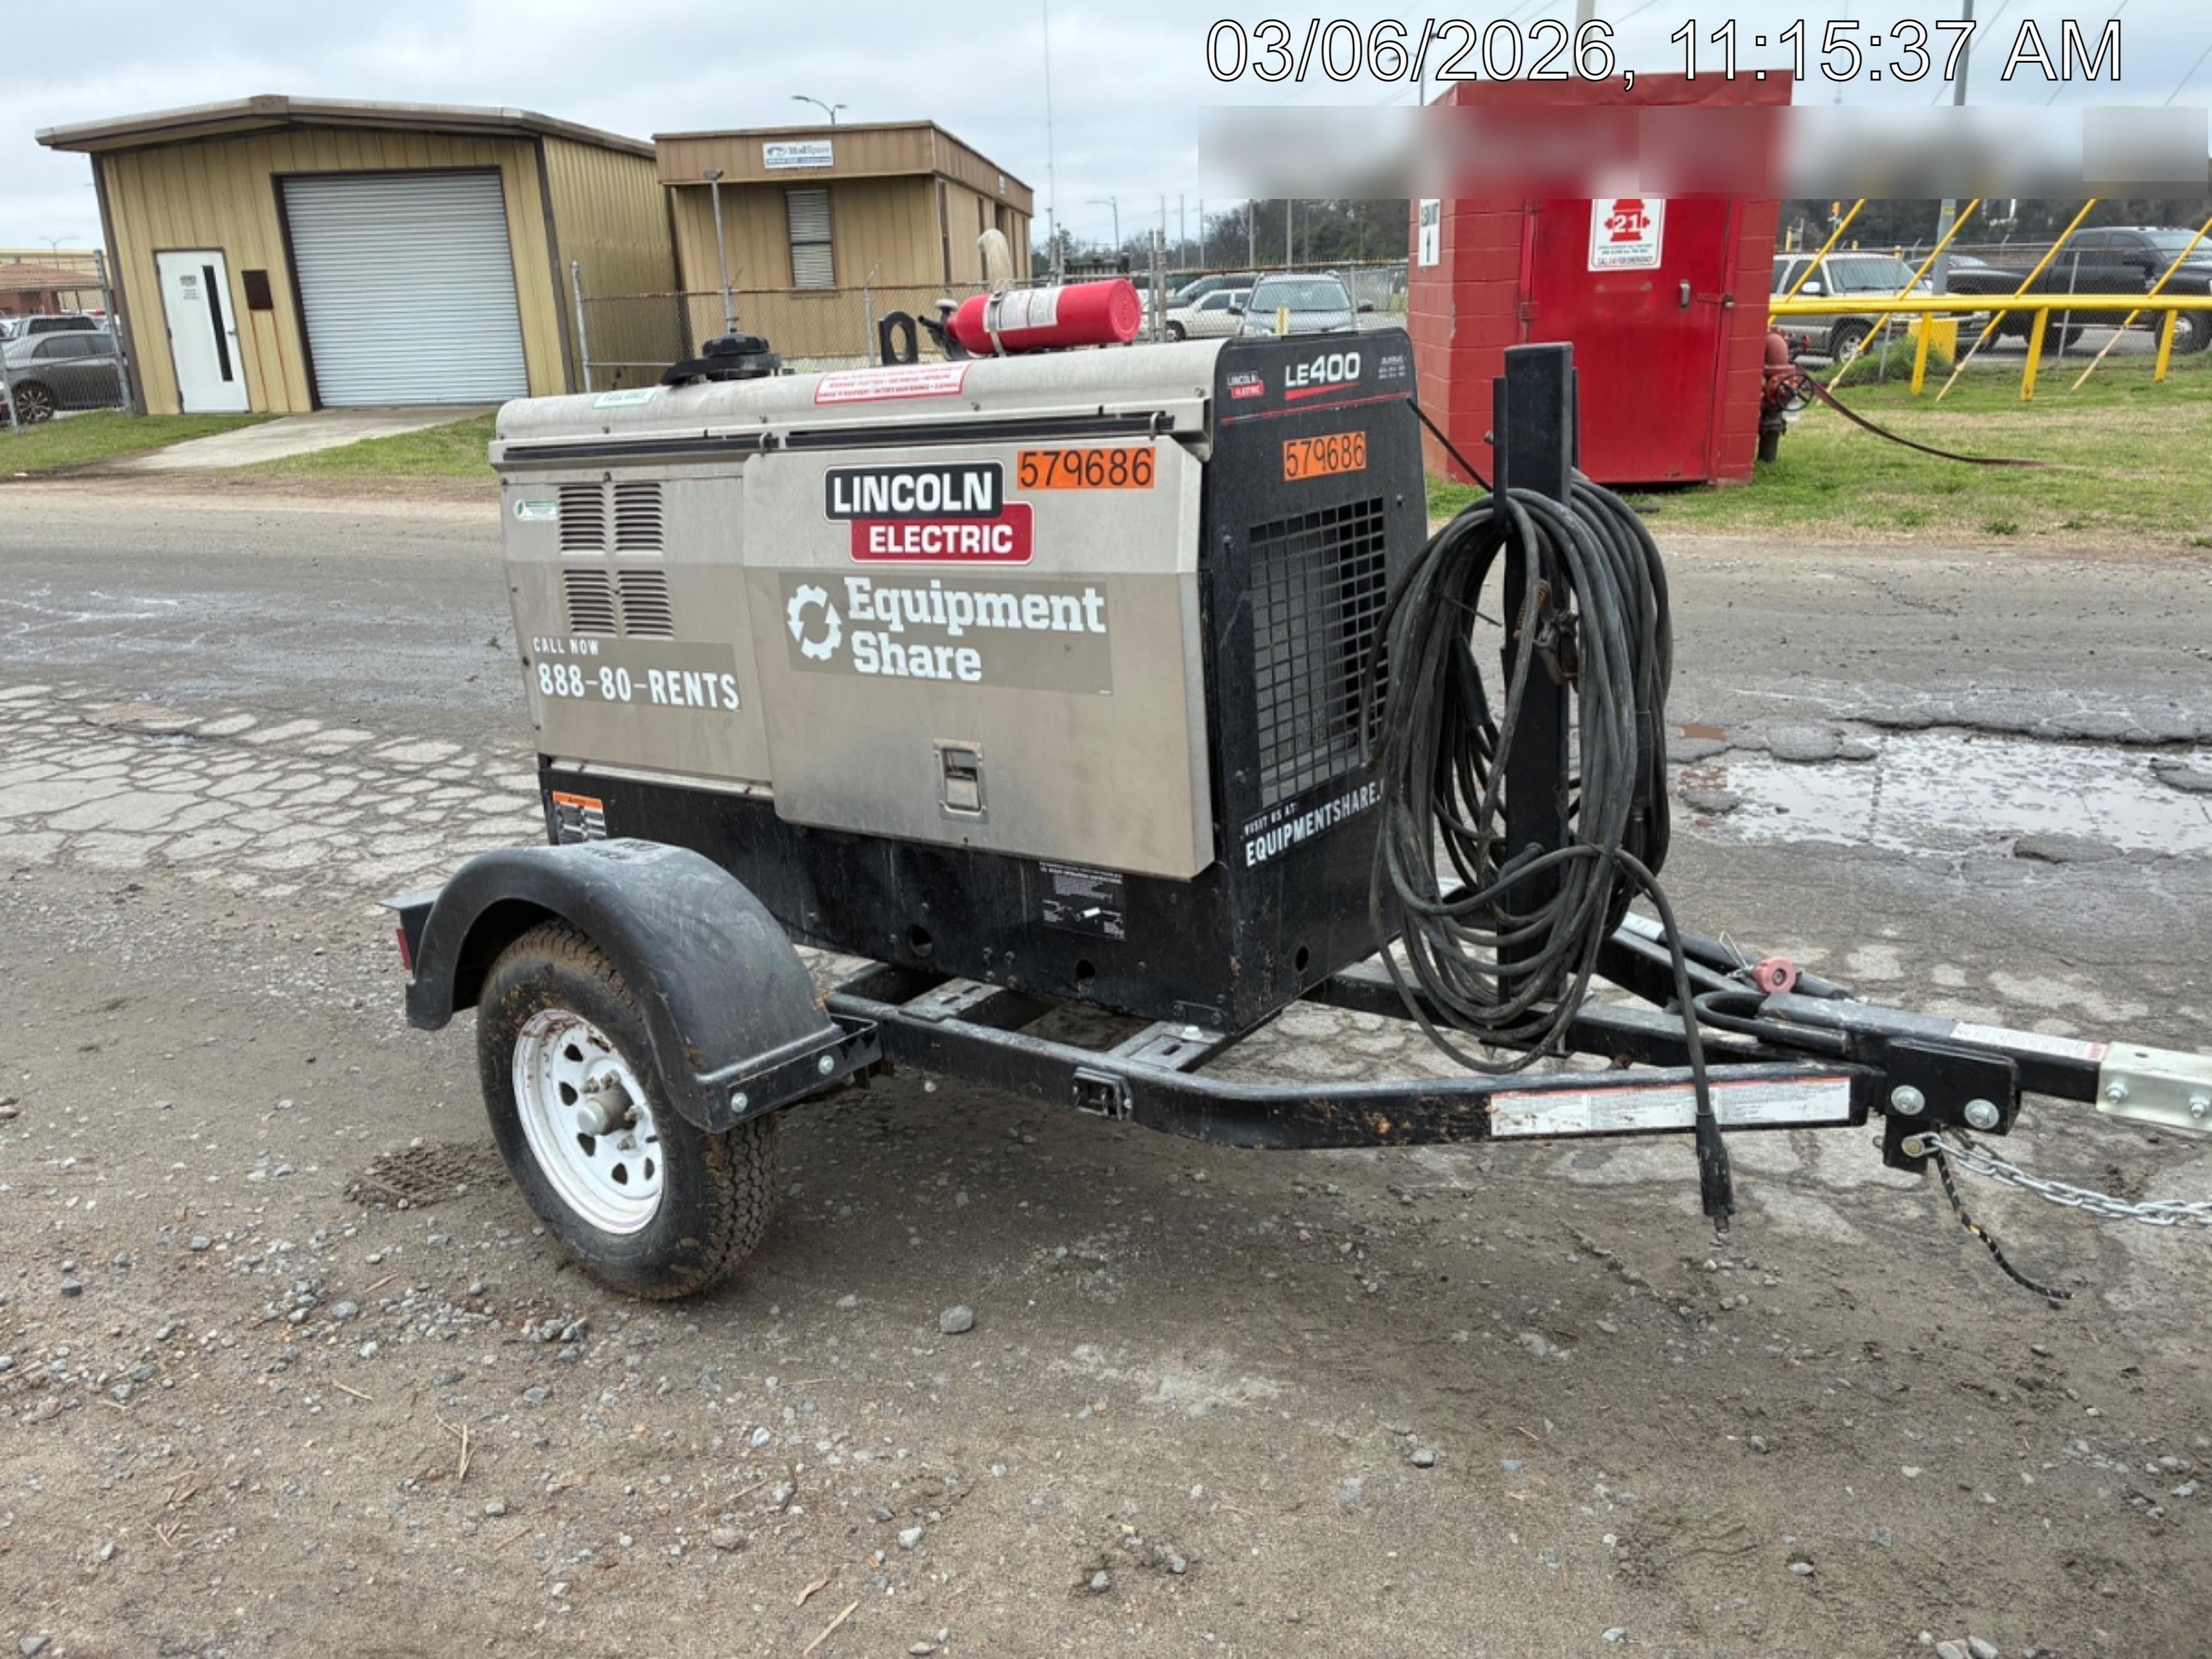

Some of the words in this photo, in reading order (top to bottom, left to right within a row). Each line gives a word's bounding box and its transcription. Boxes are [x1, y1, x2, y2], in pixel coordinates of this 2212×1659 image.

[1614, 213, 1641, 232] 21
[1285, 351, 1361, 387] LE400
[1021, 448, 1152, 487] 579686
[1287, 433, 1364, 477] 579686
[834, 471, 993, 513] LINCOLN
[869, 524, 1013, 553] ELECTRIC
[844, 576, 1107, 637] Equipment
[533, 637, 565, 654] CALL
[570, 639, 598, 656] NOW
[851, 630, 982, 682] Share
[538, 662, 740, 710] 888-80-RENTS
[1245, 779, 1384, 867] EQUIPMENTSHARE.
